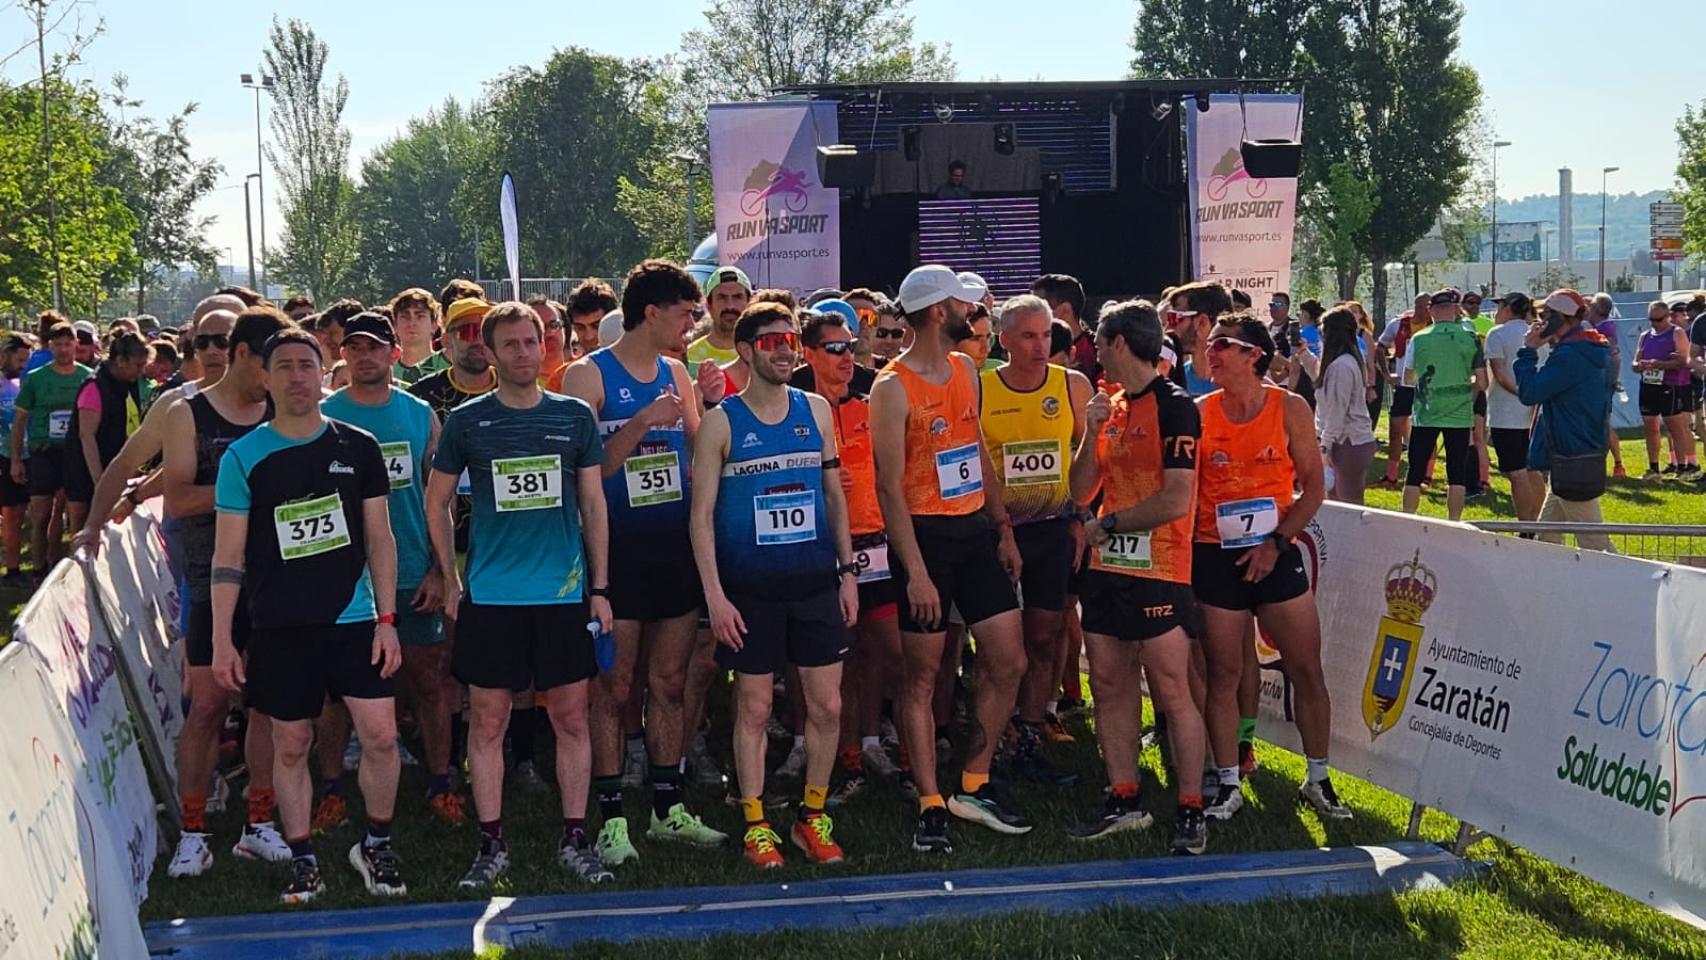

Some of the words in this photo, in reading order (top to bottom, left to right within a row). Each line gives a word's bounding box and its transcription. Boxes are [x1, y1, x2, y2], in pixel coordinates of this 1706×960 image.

[726, 247, 831, 262] www.runvasport.es
[1235, 276, 1274, 289] NIGHT
[1164, 435, 1195, 459] TR
[384, 457, 404, 475] 4
[733, 460, 780, 476] LAGUNA
[959, 461, 970, 480] 6
[1012, 453, 1055, 472] 400
[507, 472, 548, 494] 381
[639, 468, 672, 490] 351
[289, 513, 335, 540] 373
[769, 508, 805, 529] 110
[1240, 514, 1255, 532] 7
[1108, 535, 1139, 554] 217
[1306, 519, 1328, 568] PORTIVA
[1143, 604, 1174, 618] TRZ
[1427, 637, 1505, 675] Ayuntamiento
[1506, 658, 1522, 680] de
[1414, 666, 1511, 733] Zaratán
[1409, 714, 1452, 742] Concejalía
[1453, 731, 1465, 747] de
[1465, 734, 1502, 760] Deportes
[1557, 735, 1672, 816] Saludable
